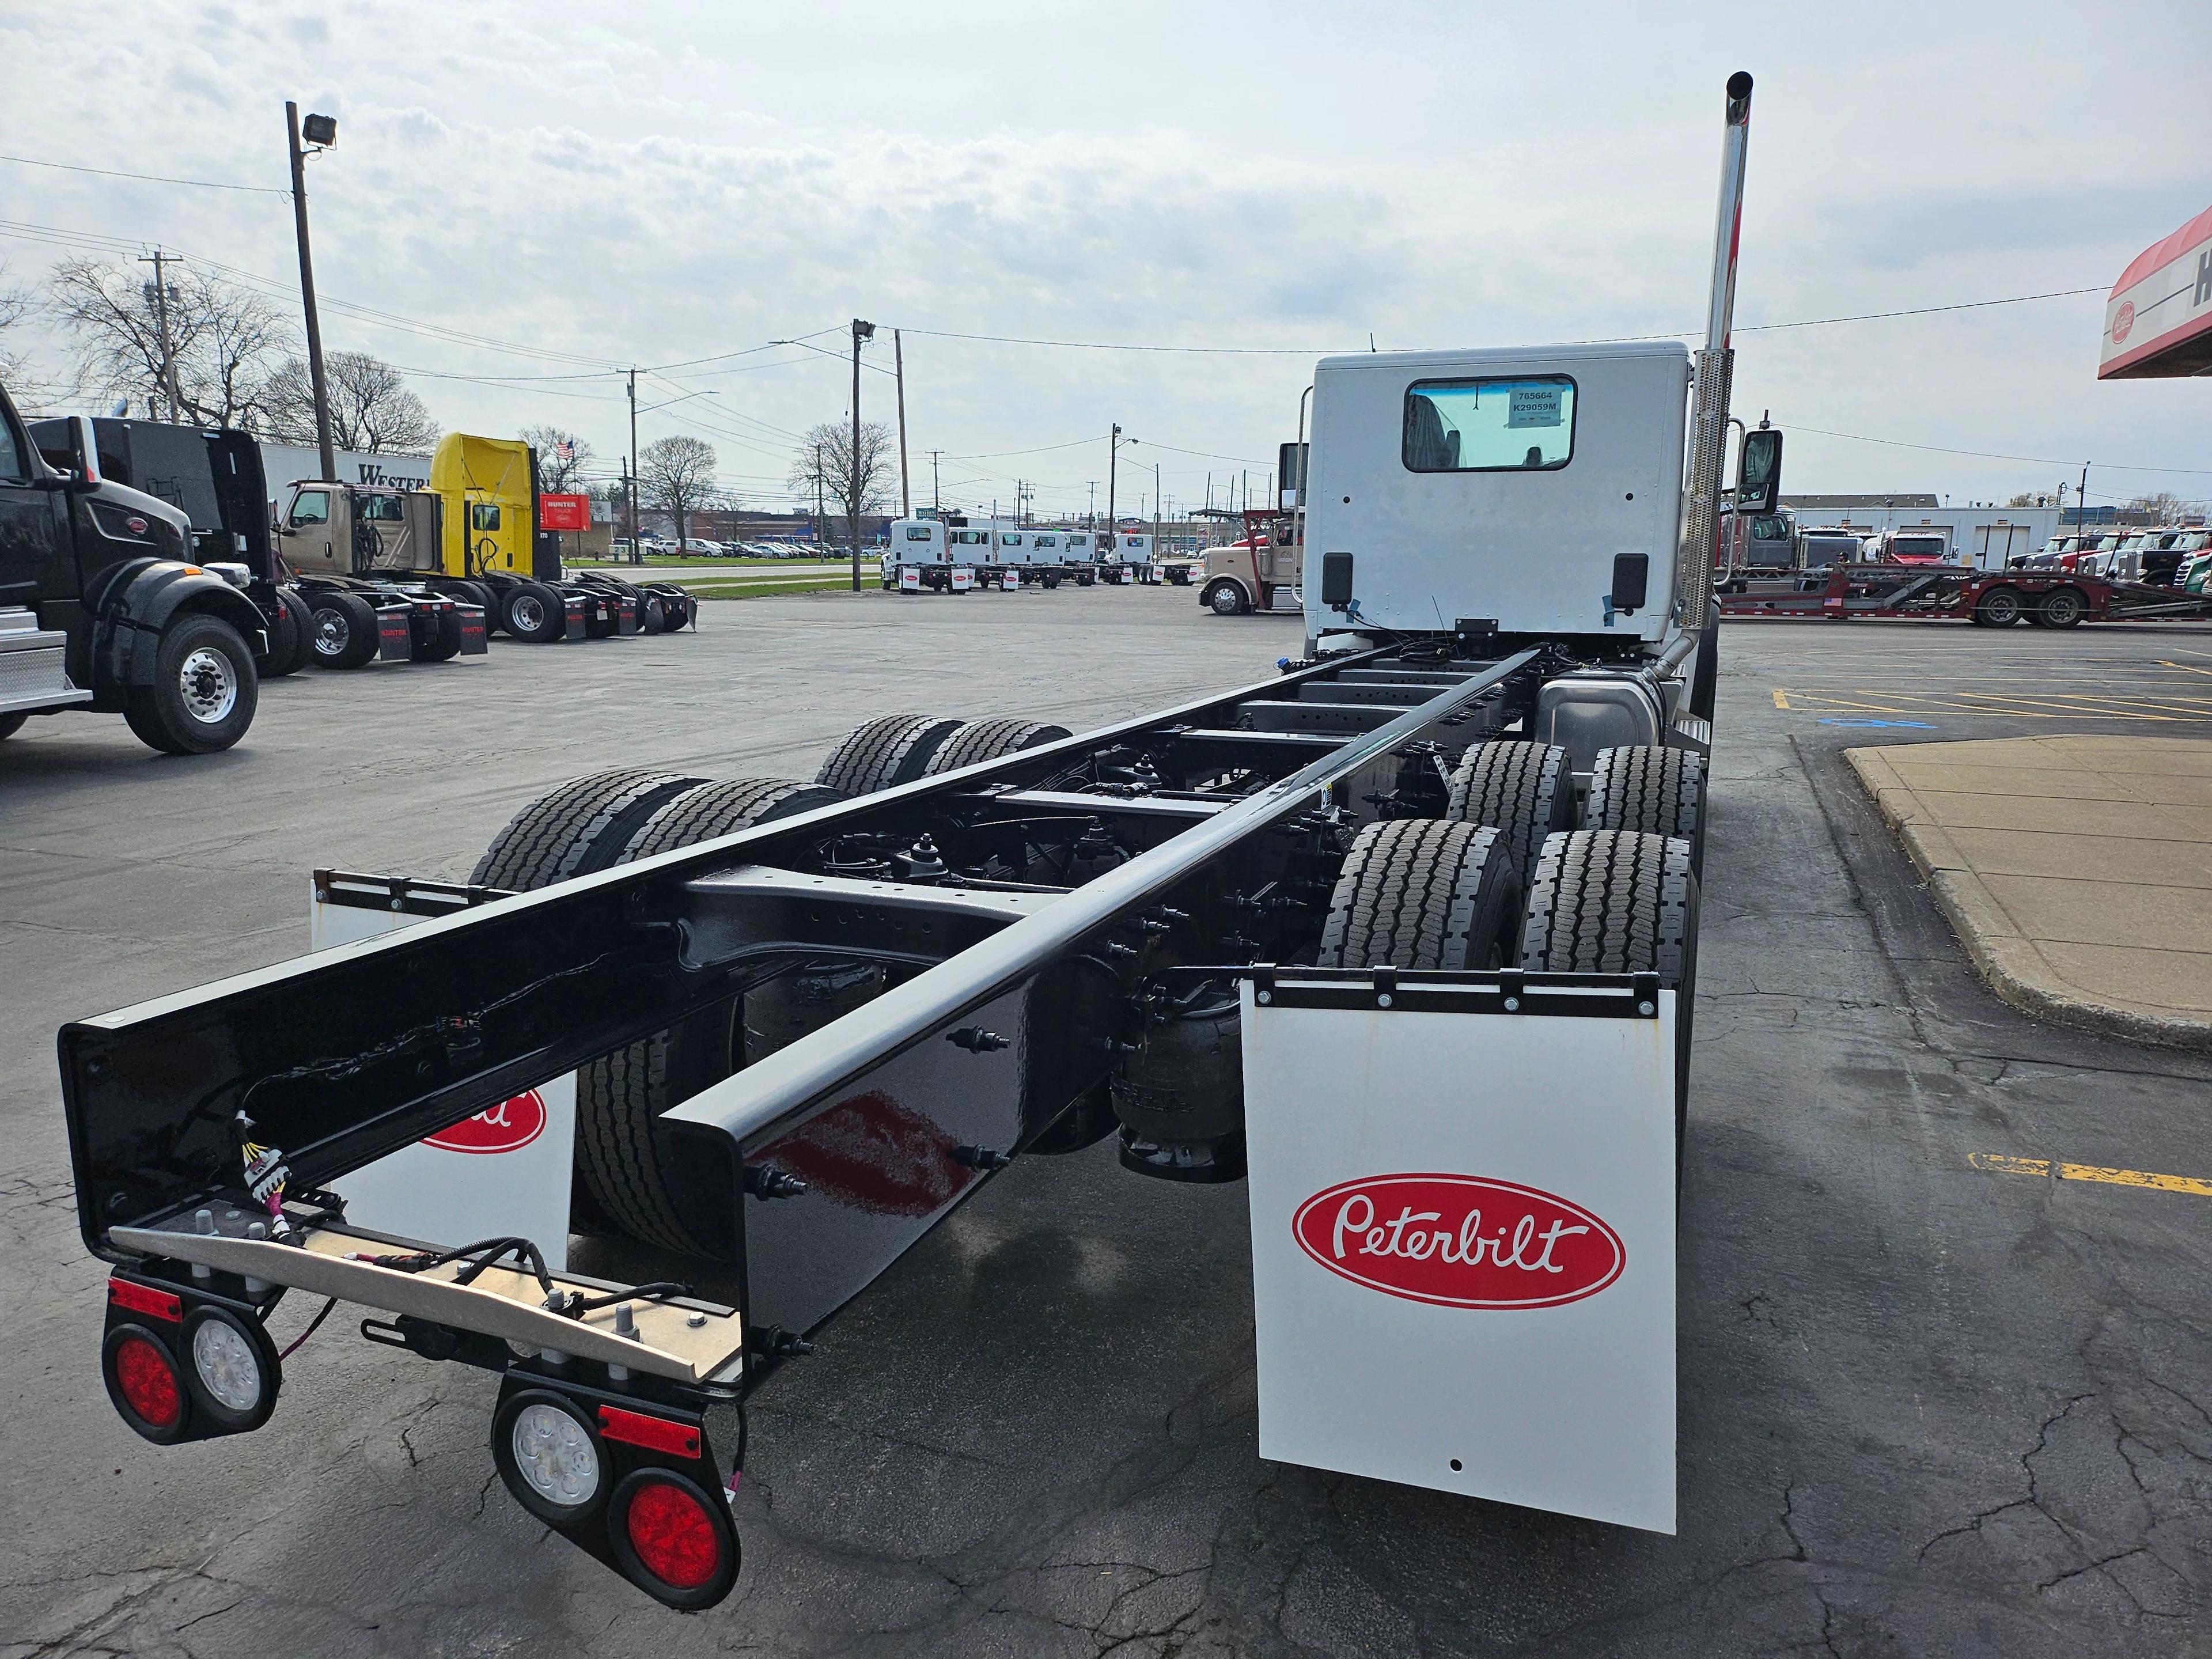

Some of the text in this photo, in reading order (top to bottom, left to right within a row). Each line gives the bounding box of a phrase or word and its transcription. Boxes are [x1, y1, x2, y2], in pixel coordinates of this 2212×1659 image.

[1519, 392, 1552, 400] 765664
[1513, 403, 1556, 411] K29059M
[1333, 1194, 1590, 1273] Peterbilt
